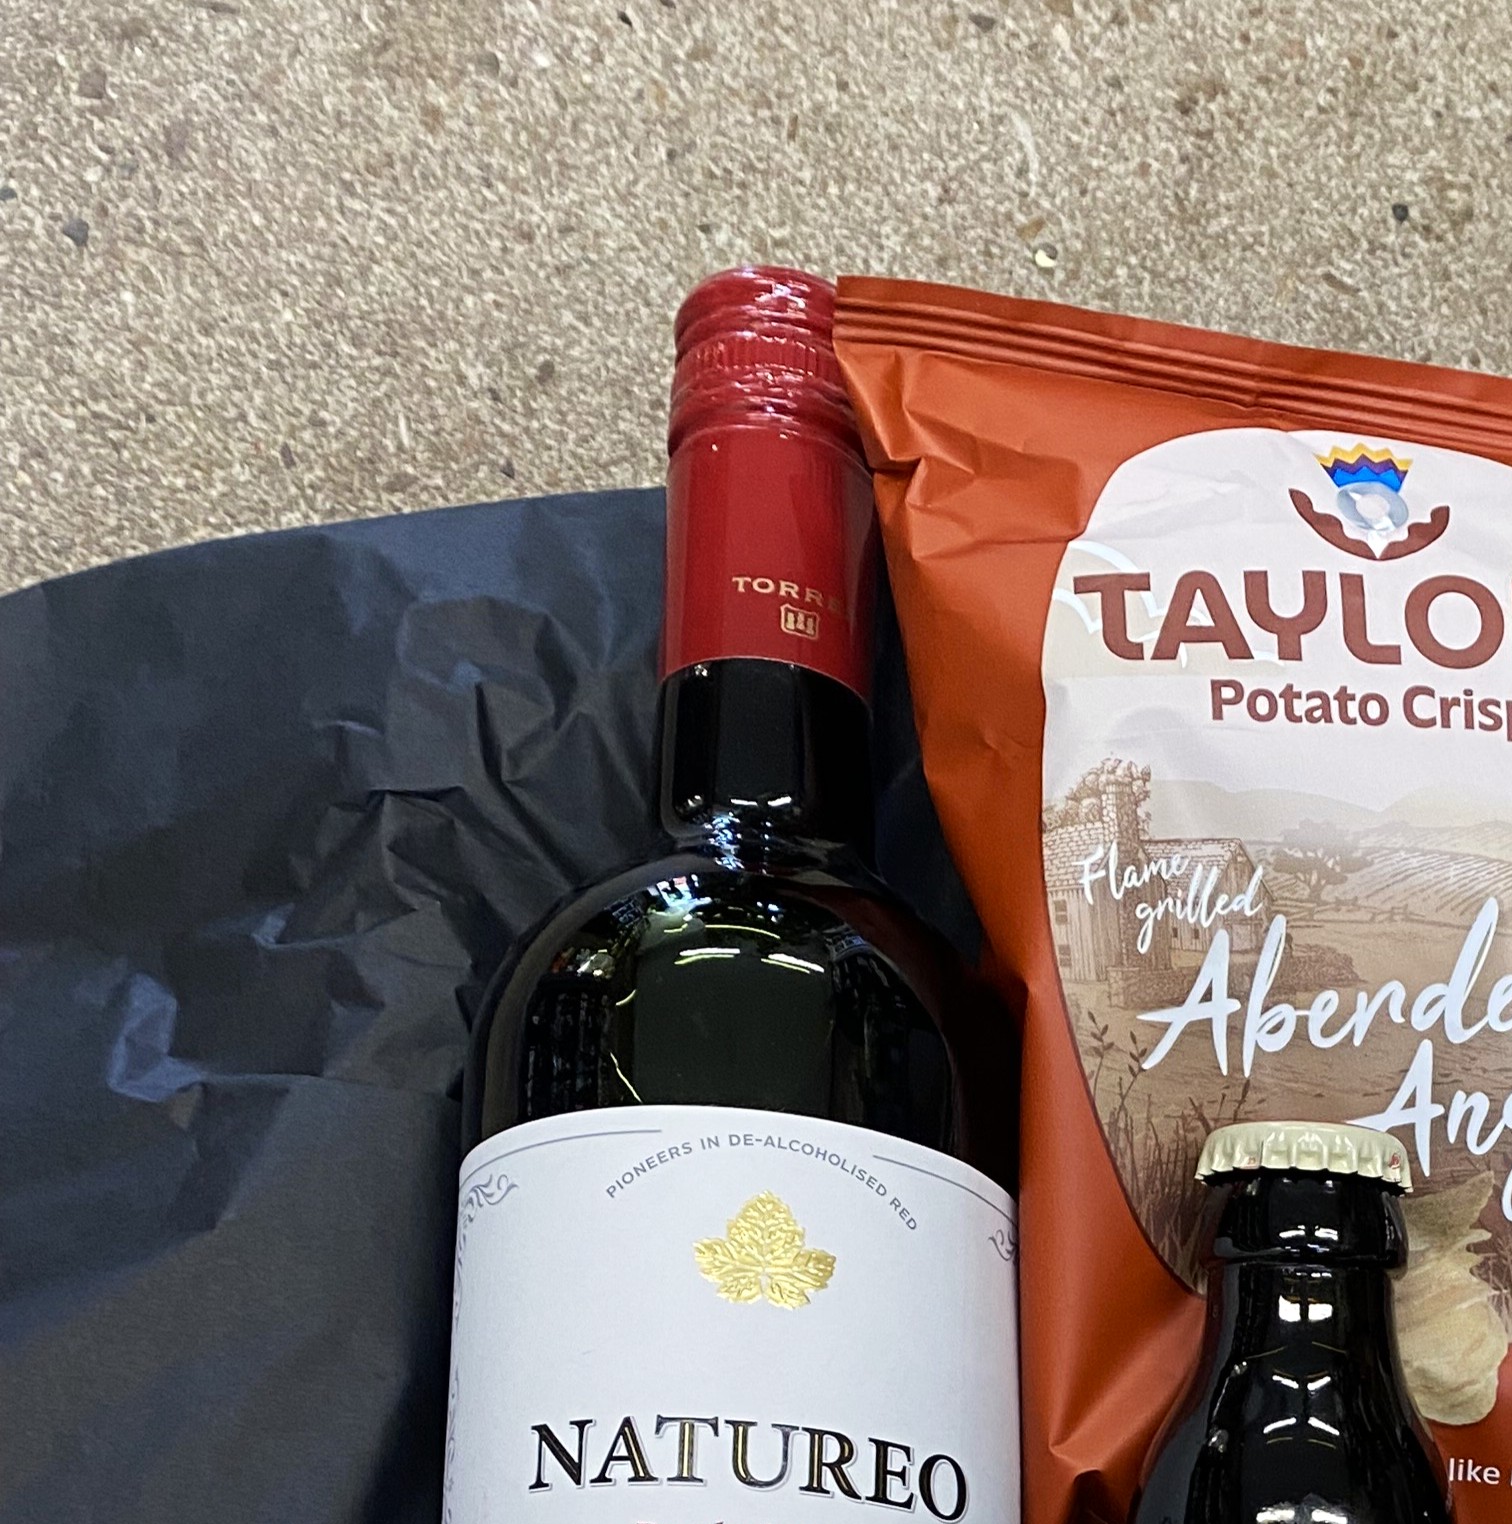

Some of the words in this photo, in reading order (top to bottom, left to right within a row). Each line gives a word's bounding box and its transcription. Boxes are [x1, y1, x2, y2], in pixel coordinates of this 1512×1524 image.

[1209, 679, 1390, 727] Potato
[1076, 841, 1190, 906] Flame
[1134, 864, 1264, 955] grilled
[606, 1141, 693, 1198] PIONEERS
[700, 1134, 721, 1151] IN
[729, 1133, 888, 1198] DE-ALCOHOLISED
[889, 1196, 918, 1231] RED
[528, 1414, 968, 1524] NATUREO
[1449, 1457, 1500, 1485] like
